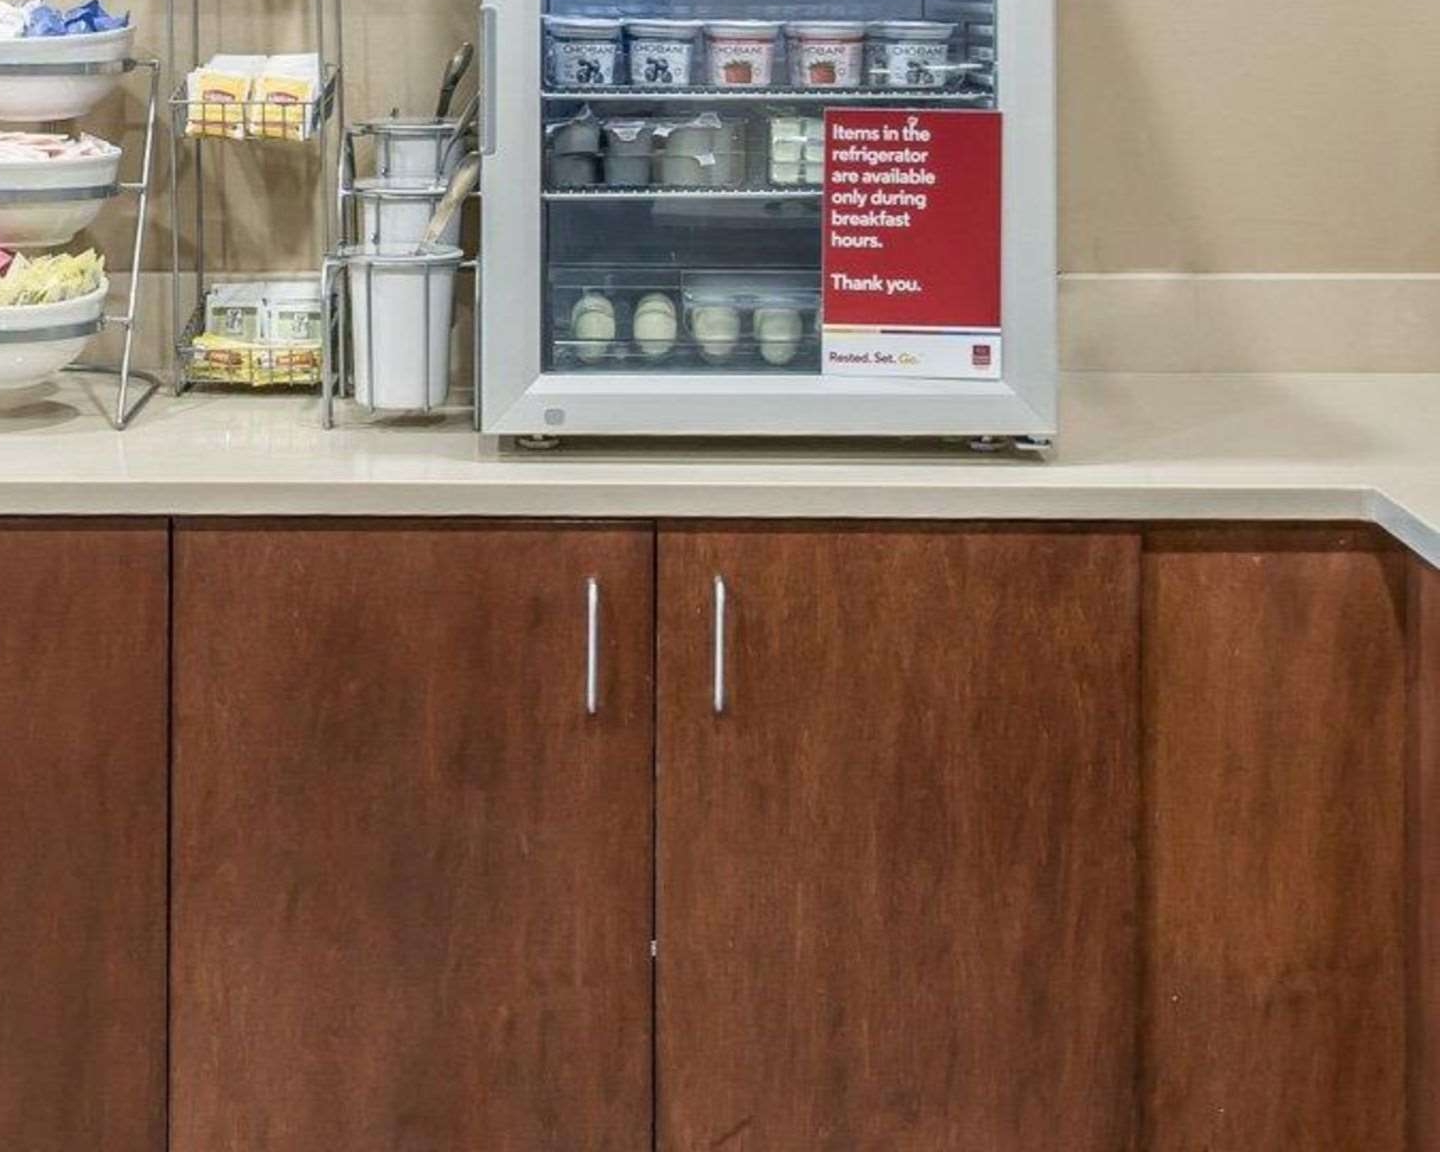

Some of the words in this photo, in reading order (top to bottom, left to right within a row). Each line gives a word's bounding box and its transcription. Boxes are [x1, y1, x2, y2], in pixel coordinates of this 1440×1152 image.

[832, 125, 880, 141] Items
[883, 125, 899, 141] in
[902, 124, 931, 142] the
[832, 146, 929, 166] refrigerator
[831, 171, 859, 183] are
[862, 169, 936, 185] available
[832, 189, 868, 208] only
[870, 189, 928, 210] during
[831, 210, 911, 227] breakfast
[831, 231, 883, 248] hours.
[830, 274, 884, 291] Thank
[887, 279, 922, 295] you.
[829, 351, 873, 364] Rested.
[874, 351, 897, 364] Set.
